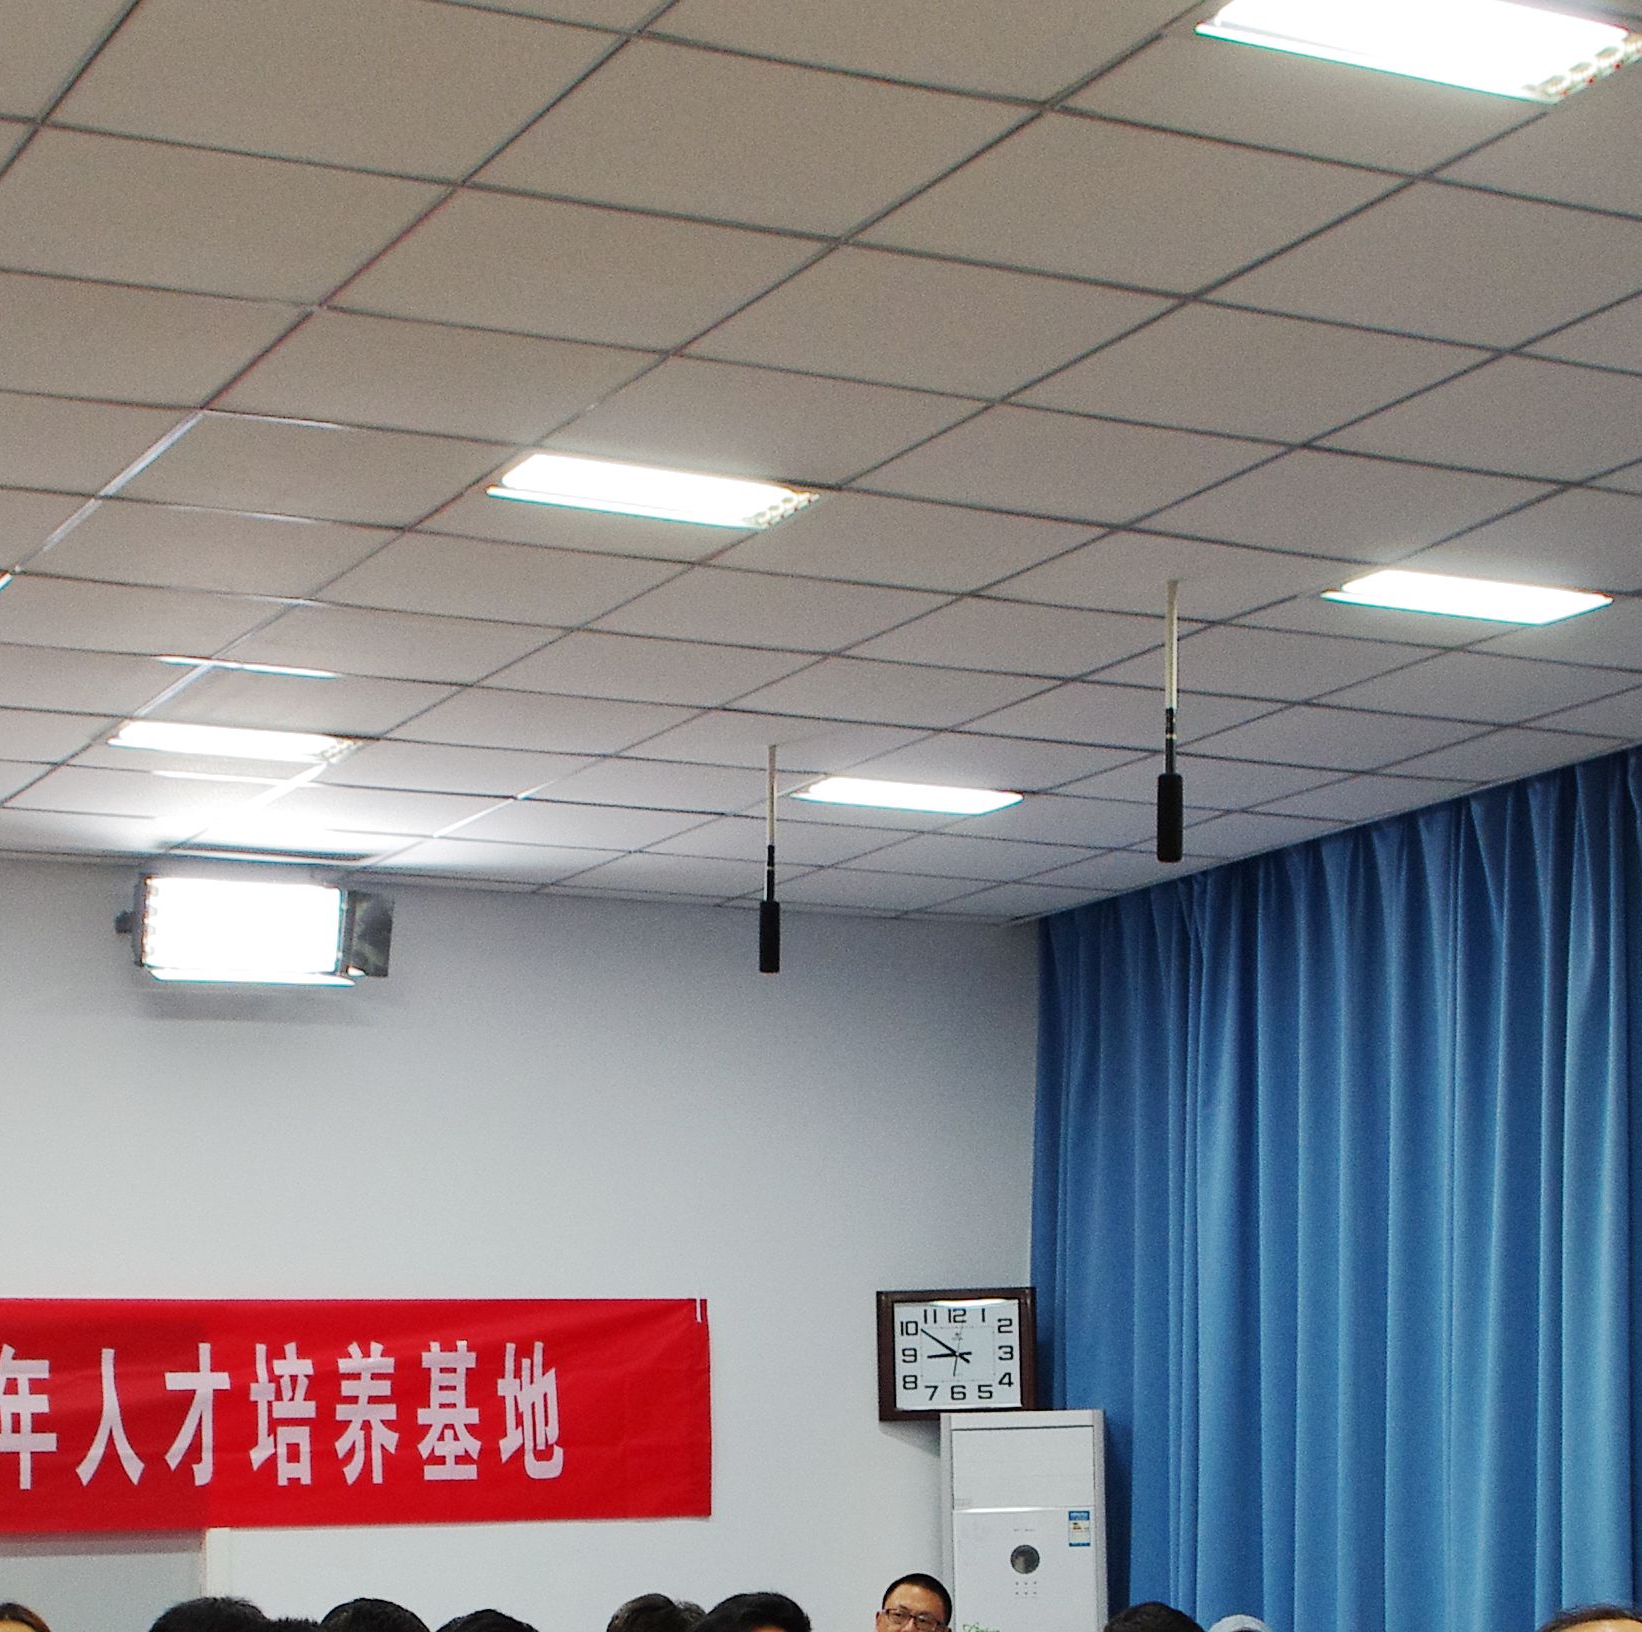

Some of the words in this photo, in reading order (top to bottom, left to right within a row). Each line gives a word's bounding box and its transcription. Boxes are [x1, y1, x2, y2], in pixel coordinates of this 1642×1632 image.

[923, 1309, 937, 1324] 11
[948, 1308, 967, 1323] 12
[900, 1320, 918, 1336] 10
[997, 1318, 1013, 1333] 2
[902, 1348, 917, 1363] 9
[998, 1345, 1014, 1361] 3
[902, 1374, 918, 1390] 8
[998, 1372, 1014, 1387] 4
[924, 1385, 939, 1401] 7
[950, 1384, 967, 1400] 6
[977, 1384, 993, 1399] 5
